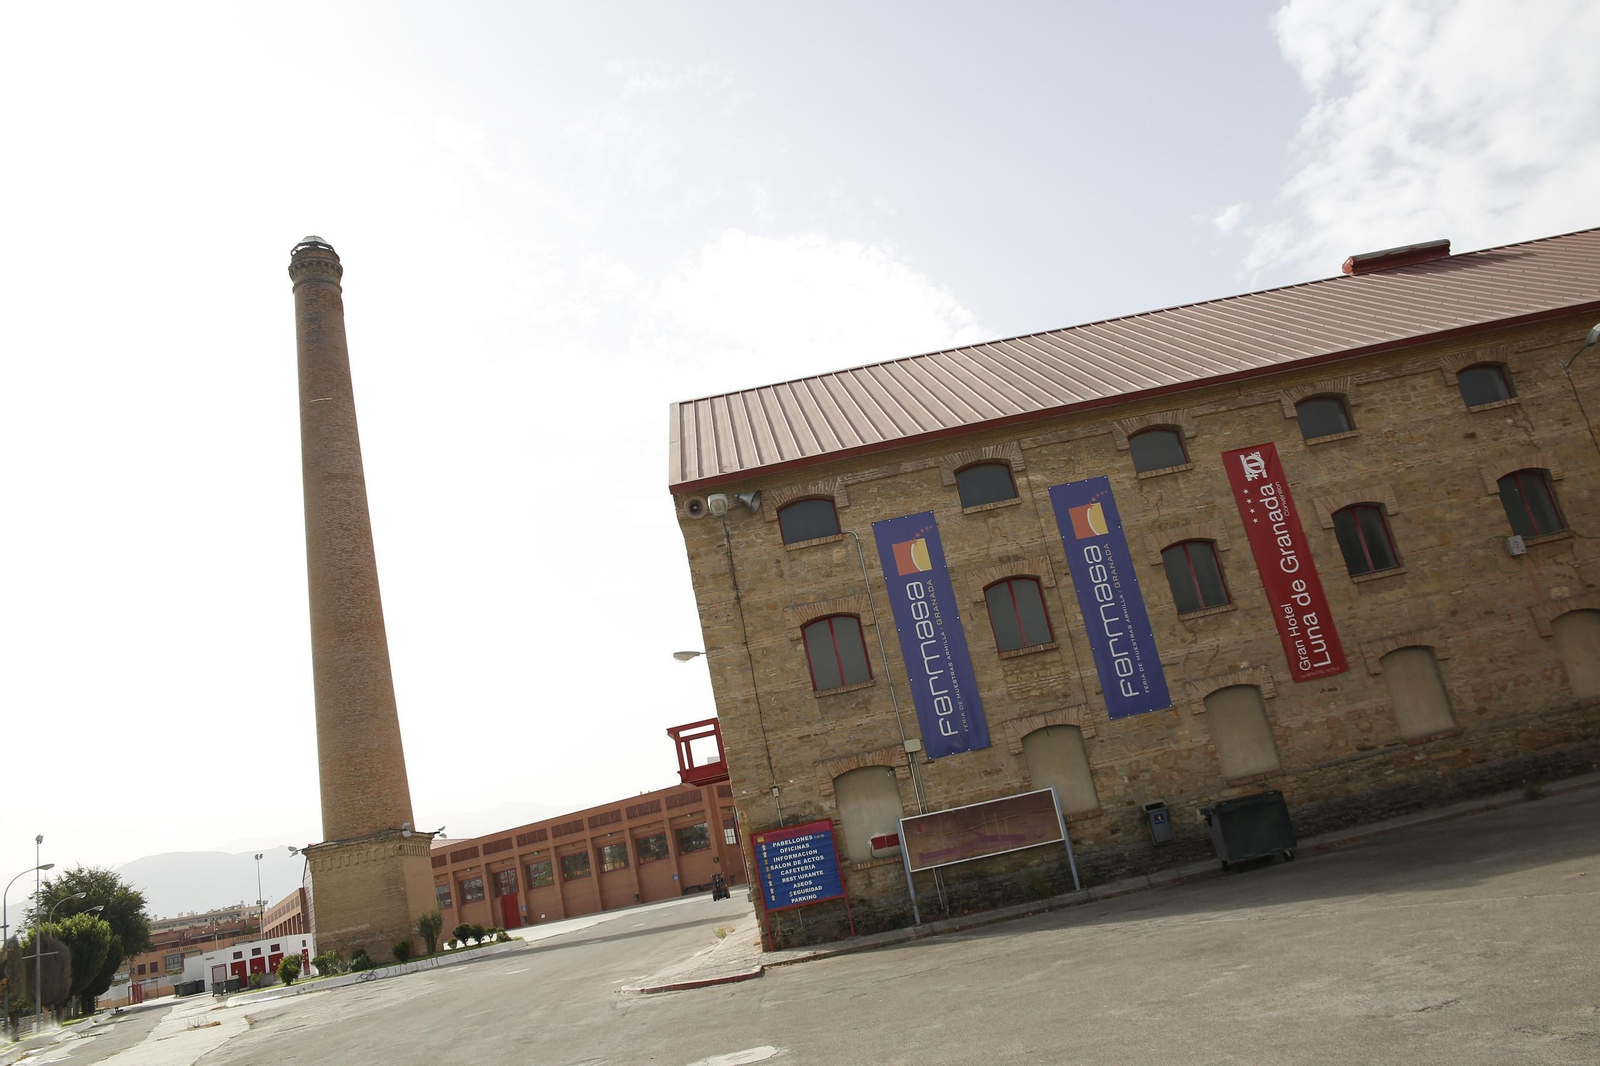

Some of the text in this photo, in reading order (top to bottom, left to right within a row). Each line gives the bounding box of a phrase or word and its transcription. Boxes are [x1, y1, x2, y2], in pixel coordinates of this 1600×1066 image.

[1276, 481, 1290, 516] Convention
[1104, 543, 1121, 589] GRANADA
[1260, 483, 1332, 667] Luna de Granada
[927, 579, 943, 625] GRANADA
[1121, 594, 1131, 624] ARMILLA
[940, 632, 952, 661] ARMILLA
[1129, 624, 1141, 661] MUESTRAS
[1281, 604, 1311, 671] Gran Hotel
[948, 663, 961, 699] MUESTRAS
[773, 835, 813, 847] PABELLONES
[780, 843, 809, 853] OFICINAS
[804, 855, 824, 863] ACTOS
[791, 894, 817, 903] PARKING
[793, 880, 812, 888] ASEOS
